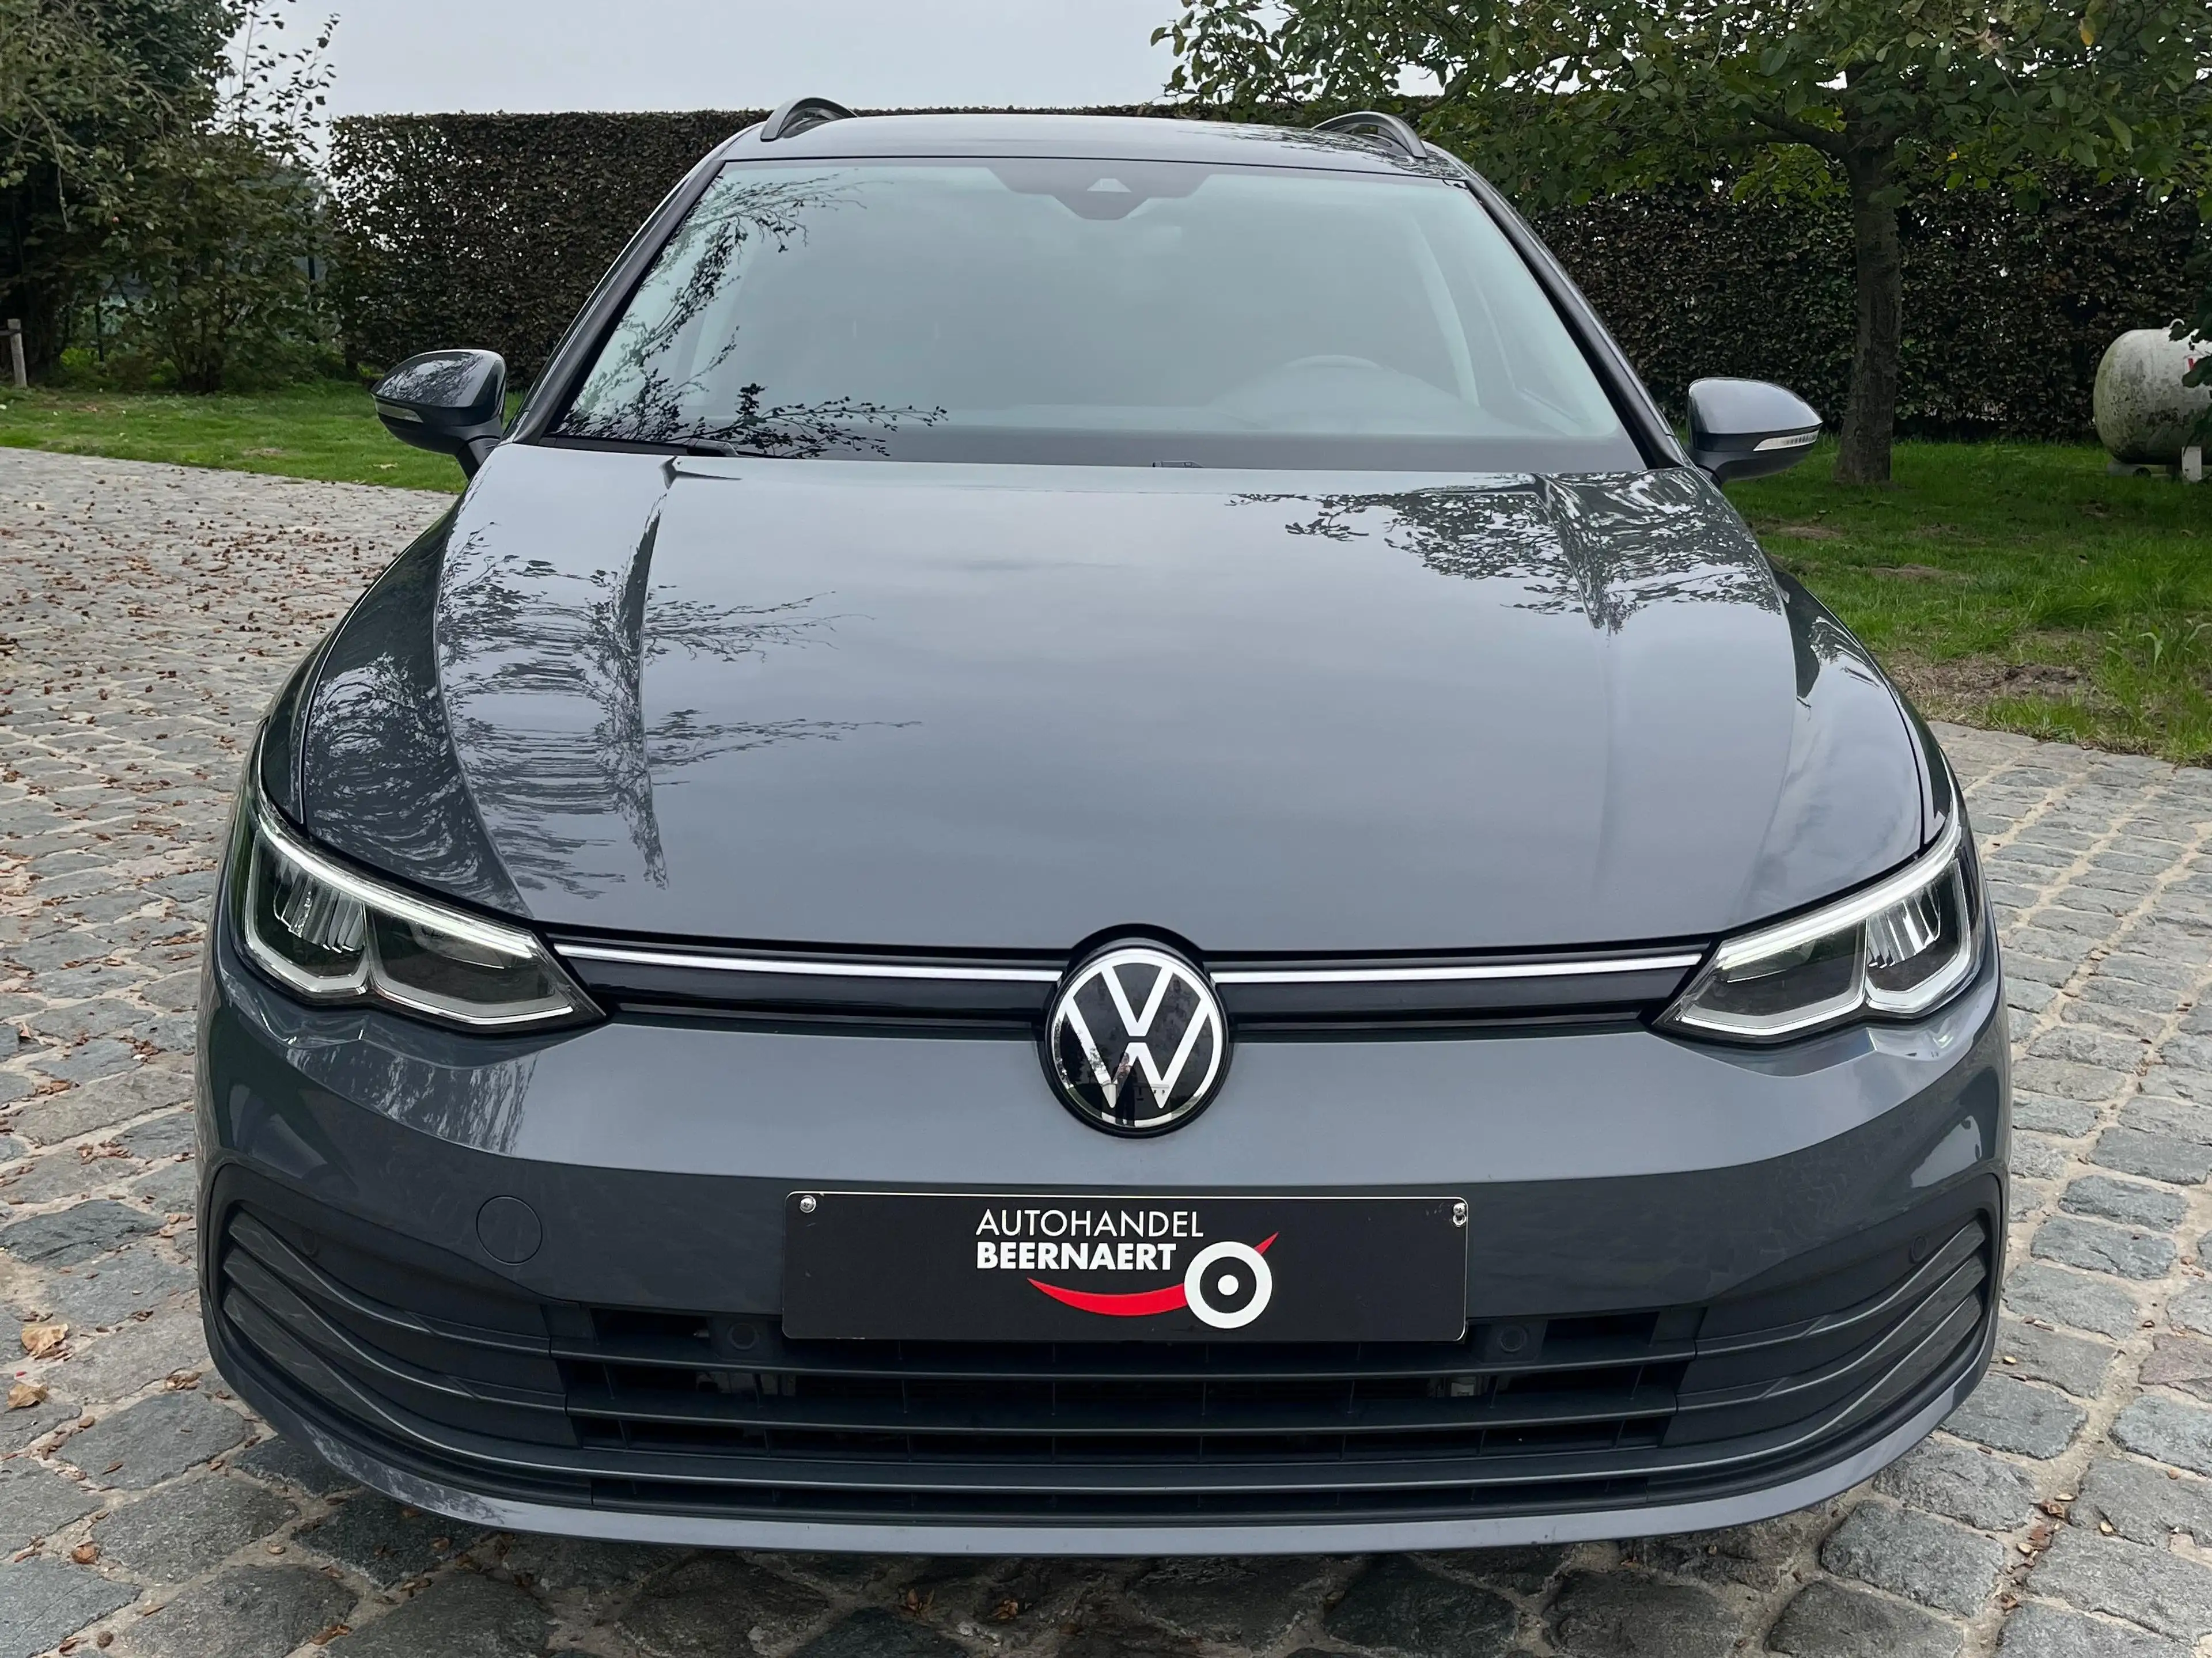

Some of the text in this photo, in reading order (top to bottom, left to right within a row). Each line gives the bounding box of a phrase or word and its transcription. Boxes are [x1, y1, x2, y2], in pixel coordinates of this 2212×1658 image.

[1059, 956, 1215, 1111] VW
[975, 1208, 1204, 1238] AUTOHANDEL
[976, 1242, 1177, 1270] BEERNAERT
